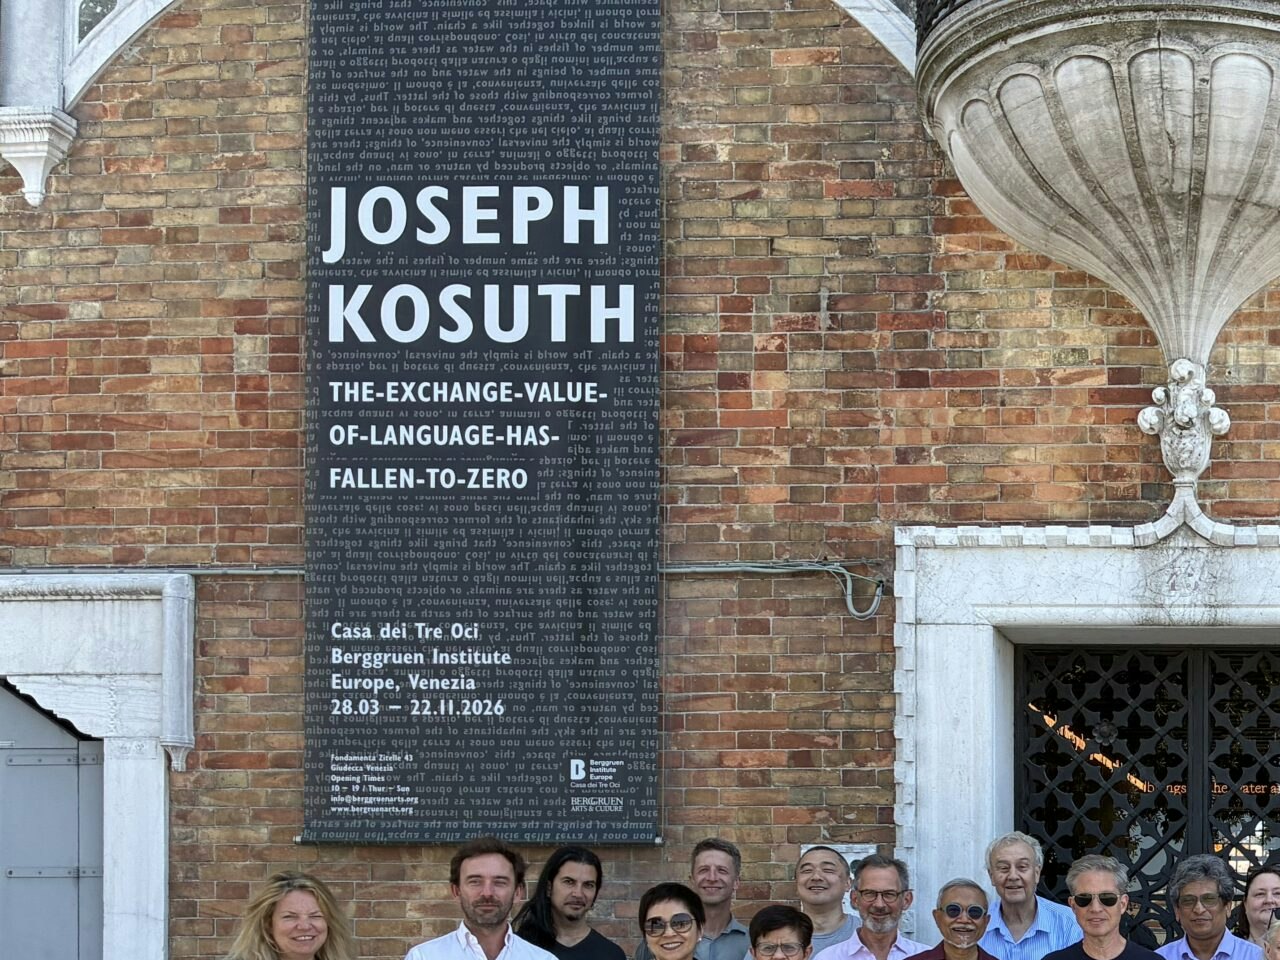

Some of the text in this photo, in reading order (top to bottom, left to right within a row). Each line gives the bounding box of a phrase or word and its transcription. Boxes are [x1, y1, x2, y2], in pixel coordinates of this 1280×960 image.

[323, 186, 609, 264] JOSEPH
[329, 284, 634, 343] KOSUTH
[330, 382, 607, 403] THE-EXCHANGE-VALUE-
[330, 425, 560, 447] OF-LANGUAGE-HAS-
[330, 468, 528, 489] FALLEN-TO-ZERO
[331, 623, 479, 639] Casa dei Tre Oci
[331, 649, 511, 668] Berggruen Institute
[331, 675, 476, 693] Europe, Venezia
[331, 700, 379, 716] 28.03
[411, 700, 504, 716] 22.11.2026
[331, 754, 376, 762] Fondamenta
[379, 754, 401, 762] Zitelle
[331, 775, 360, 783] Opening
[1240, 782, 1267, 794] ater
